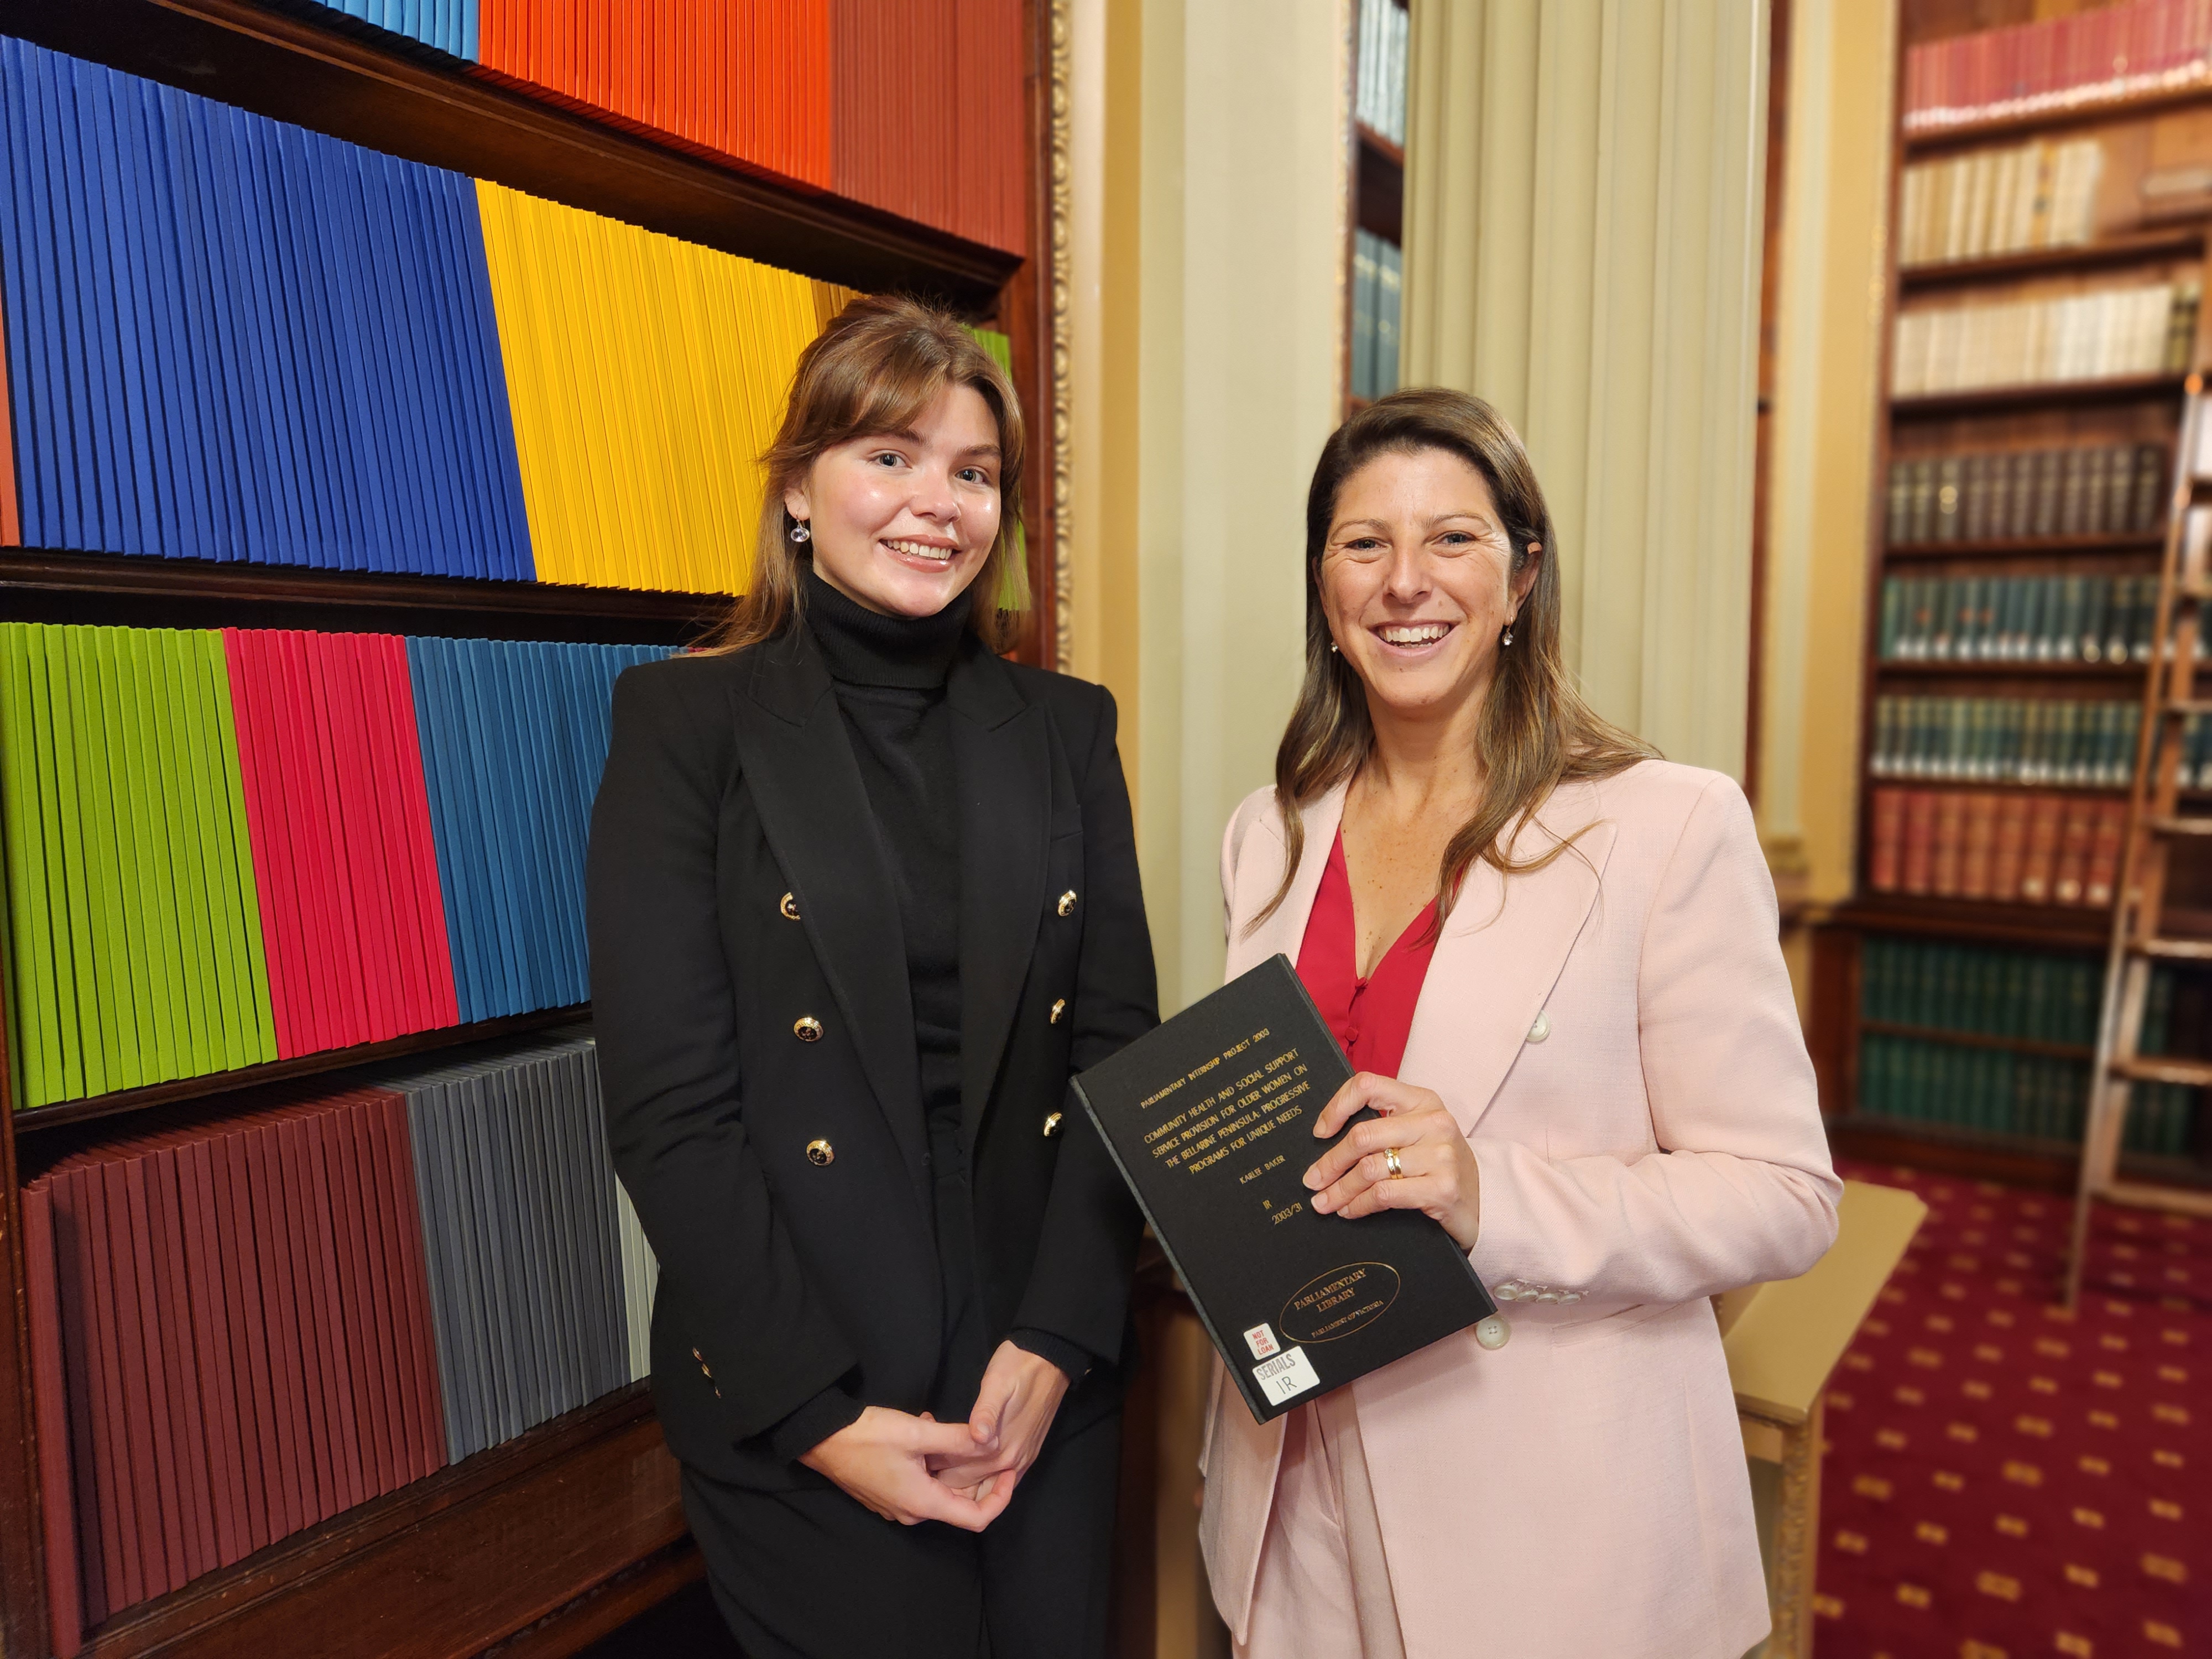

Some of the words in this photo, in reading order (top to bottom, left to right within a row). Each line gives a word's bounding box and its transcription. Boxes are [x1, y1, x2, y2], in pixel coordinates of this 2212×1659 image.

[1141, 1077, 1186, 1109] PARLIAMENTARY
[1188, 1057, 1220, 1081] INTERNSHIP
[1223, 1039, 1250, 1060] PROJECT
[1253, 1028, 1270, 1042] 2003
[1144, 1113, 1187, 1144] COMMUNITY
[1188, 1097, 1216, 1119] HEALTH
[1218, 1086, 1235, 1103] AND
[1236, 1070, 1264, 1091] SOCIAL
[1265, 1048, 1299, 1073] SUPPORT
[1152, 1138, 1181, 1158] SERVICE
[1181, 1114, 1219, 1141] PROVISION
[1220, 1104, 1237, 1119] FOR
[1237, 1091, 1261, 1108] OLDER
[1261, 1072, 1292, 1094] WOMEN
[1294, 1063, 1308, 1076] ON
[1165, 1156, 1181, 1168] THE
[1181, 1134, 1217, 1160] BELLARINE
[1261, 1081, 1311, 1114] PROGRESSIVE
[1188, 1147, 1229, 1174] PROGRAMS
[1230, 1138, 1246, 1152] FOR
[1246, 1120, 1276, 1142] UNIQUE
[1276, 1105, 1302, 1124] NEEDS
[1239, 1167, 1263, 1185] KARLEE
[1264, 1155, 1286, 1171] BAKER
[1262, 1199, 1272, 1209] IR
[1272, 1202, 1303, 1225] 2003/31
[1294, 1269, 1366, 1310] PARLIAMENTARY
[1316, 1287, 1356, 1312] LIBRARY
[1252, 1330, 1264, 1339] NOT
[1256, 1338, 1269, 1347] FOR
[1258, 1344, 1274, 1355] LOAN
[1256, 1353, 1296, 1380] SERIALS
[1276, 1376, 1297, 1394] IR
